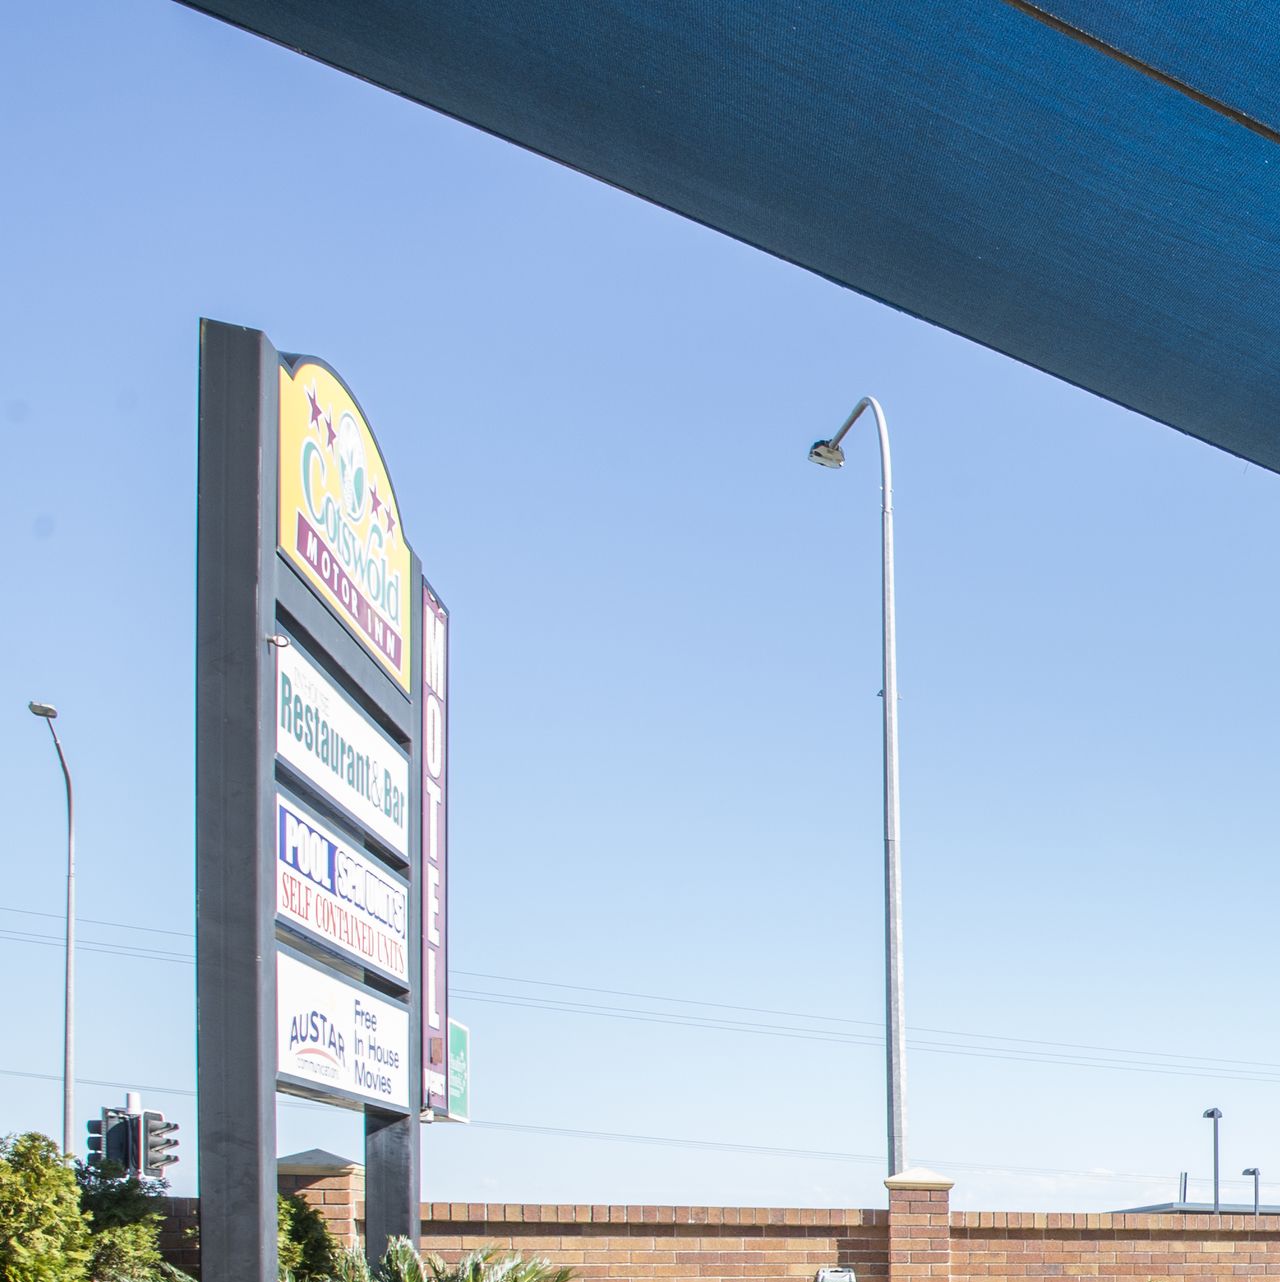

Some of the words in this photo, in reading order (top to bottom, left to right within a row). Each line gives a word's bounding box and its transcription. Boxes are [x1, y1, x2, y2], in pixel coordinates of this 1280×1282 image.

[302, 440, 399, 623] Cotswold
[306, 531, 359, 619] MOTOR
[367, 612, 396, 659] INN
[280, 671, 371, 802] Restaurant
[371, 760, 383, 813] &
[383, 767, 405, 829] Bar
[285, 811, 332, 890] POOL
[337, 851, 366, 911] SPA
[425, 603, 444, 1031] MOTEL
[282, 871, 312, 921] SELF
[315, 892, 375, 958] CONTAINED
[377, 930, 405, 975] UNITS
[289, 1010, 346, 1068] AUSTAR
[354, 999, 377, 1032] Free
[354, 1029, 364, 1057] In
[369, 1034, 399, 1069] House
[354, 1059, 392, 1095] Movies
